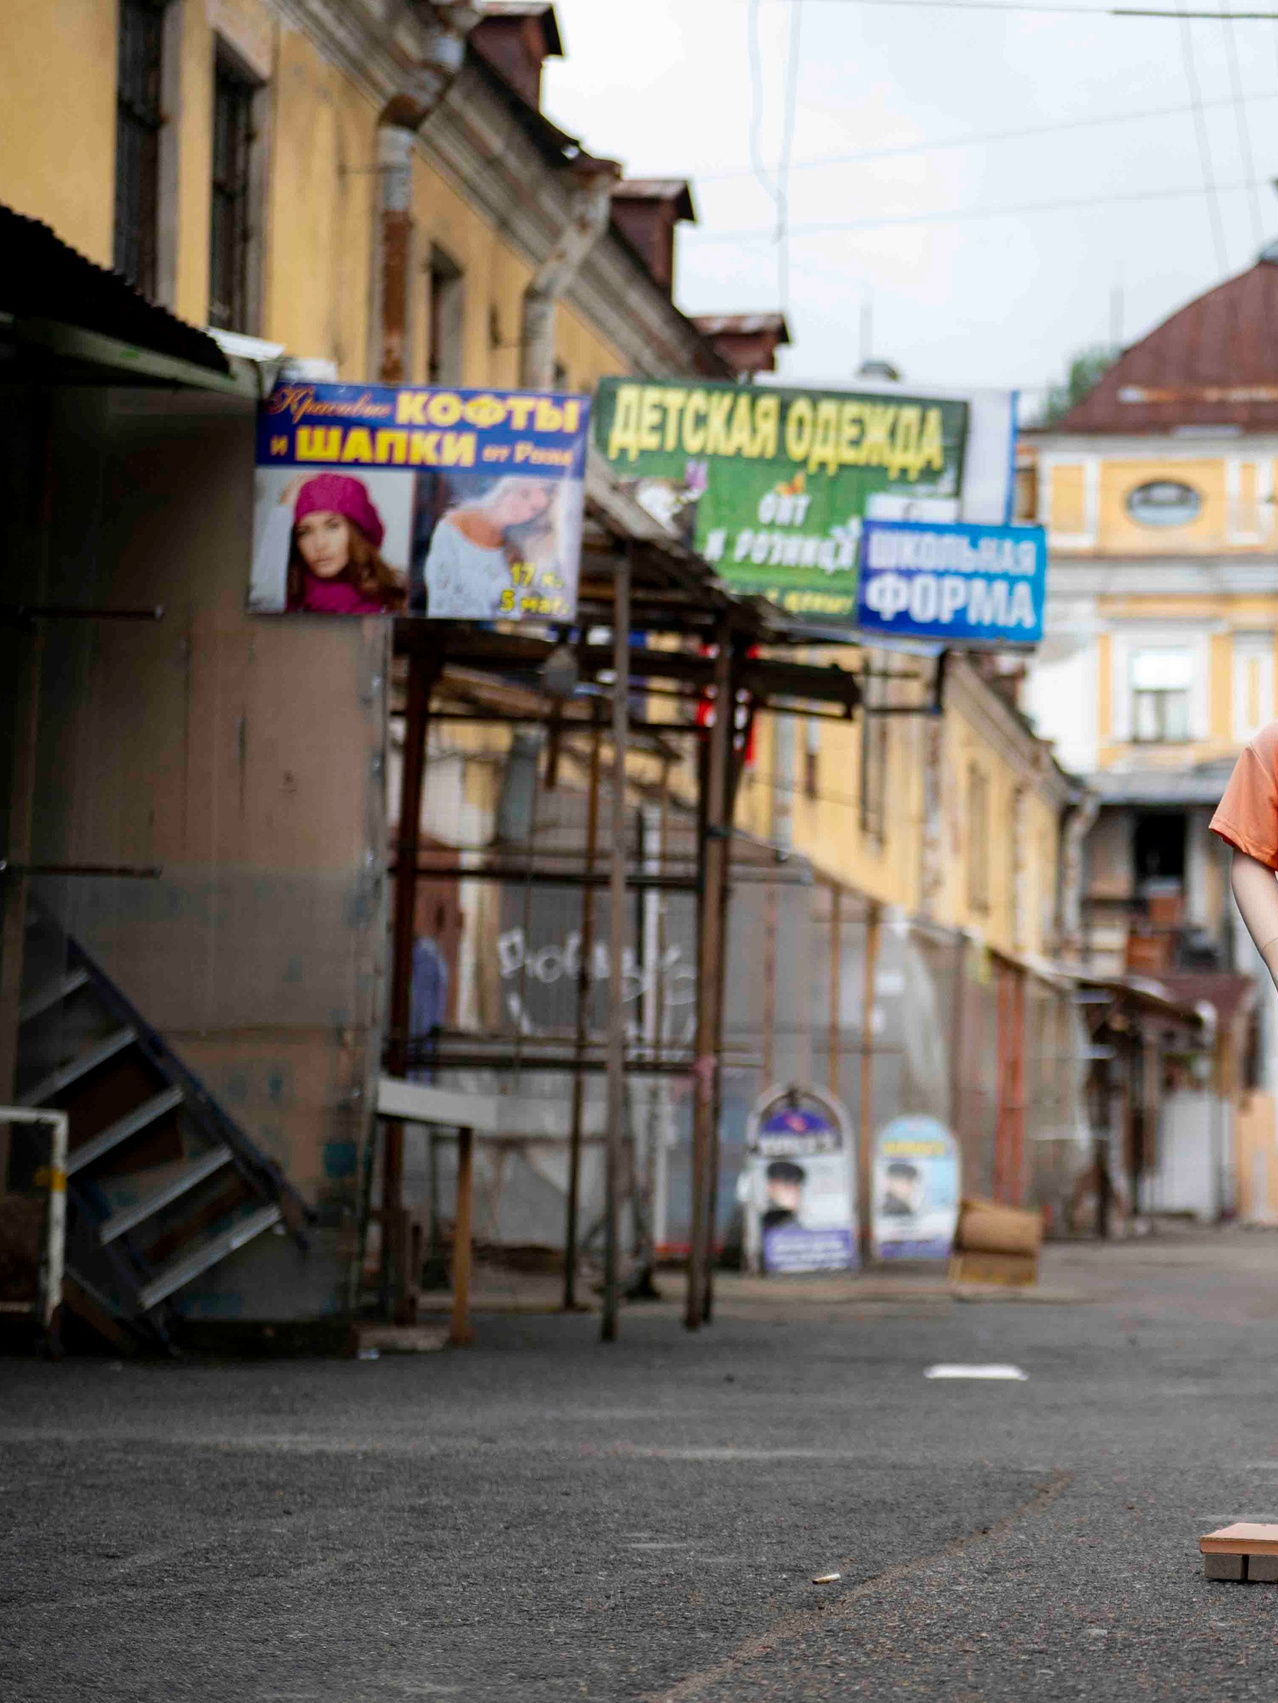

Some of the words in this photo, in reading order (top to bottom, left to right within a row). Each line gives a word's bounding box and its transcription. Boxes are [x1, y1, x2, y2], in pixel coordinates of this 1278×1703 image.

[395, 390, 580, 433] КОФТЫ
[607, 383, 780, 461] ДЕТСКАЯ
[785, 398, 944, 482] ОДЕЖДА
[294, 425, 477, 468] ШАПКИ
[867, 528, 1036, 576] ШКОЛЬНАЯ
[510, 562, 536, 587] 17
[500, 589, 516, 613] 5
[865, 574, 1036, 629] ФОРМА
